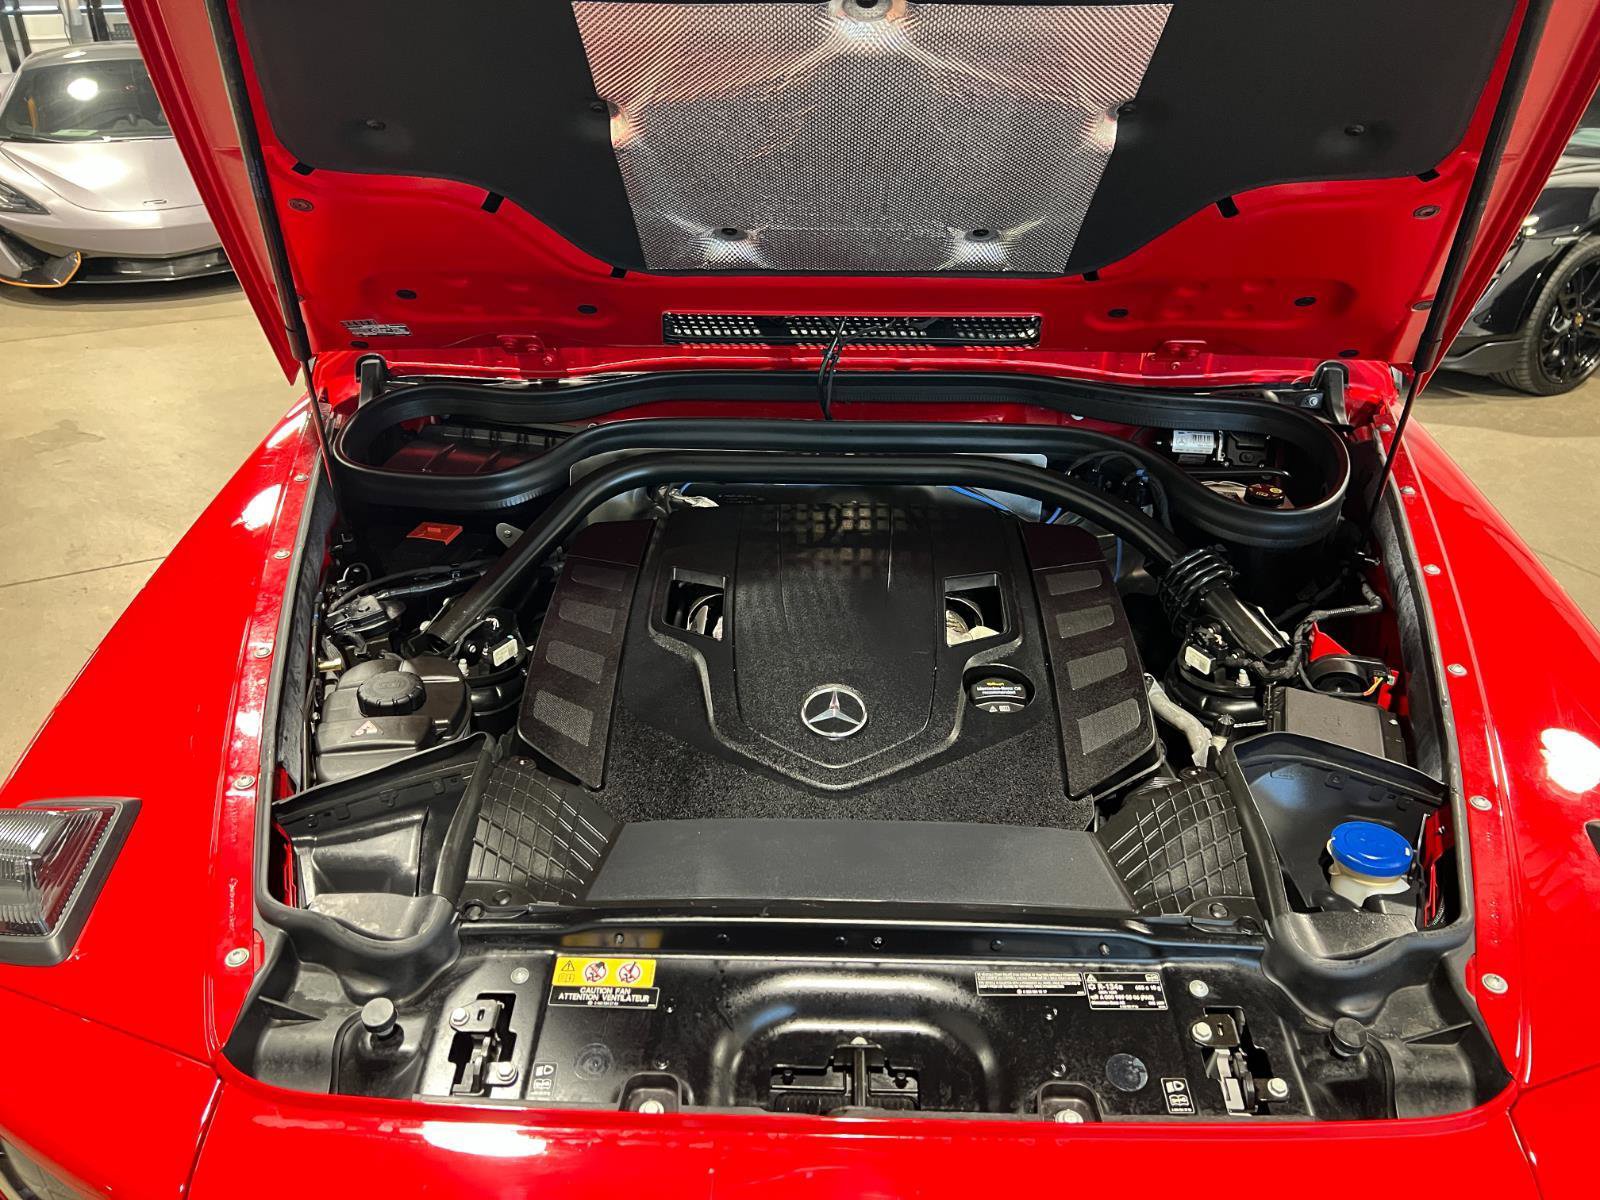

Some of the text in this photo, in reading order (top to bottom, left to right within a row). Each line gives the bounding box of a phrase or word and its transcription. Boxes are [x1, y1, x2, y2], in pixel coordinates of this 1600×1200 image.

[614, 987, 631, 995] FAN
[558, 992, 599, 1001] ATTENTION
[602, 994, 649, 1003] VENTILATEUR
